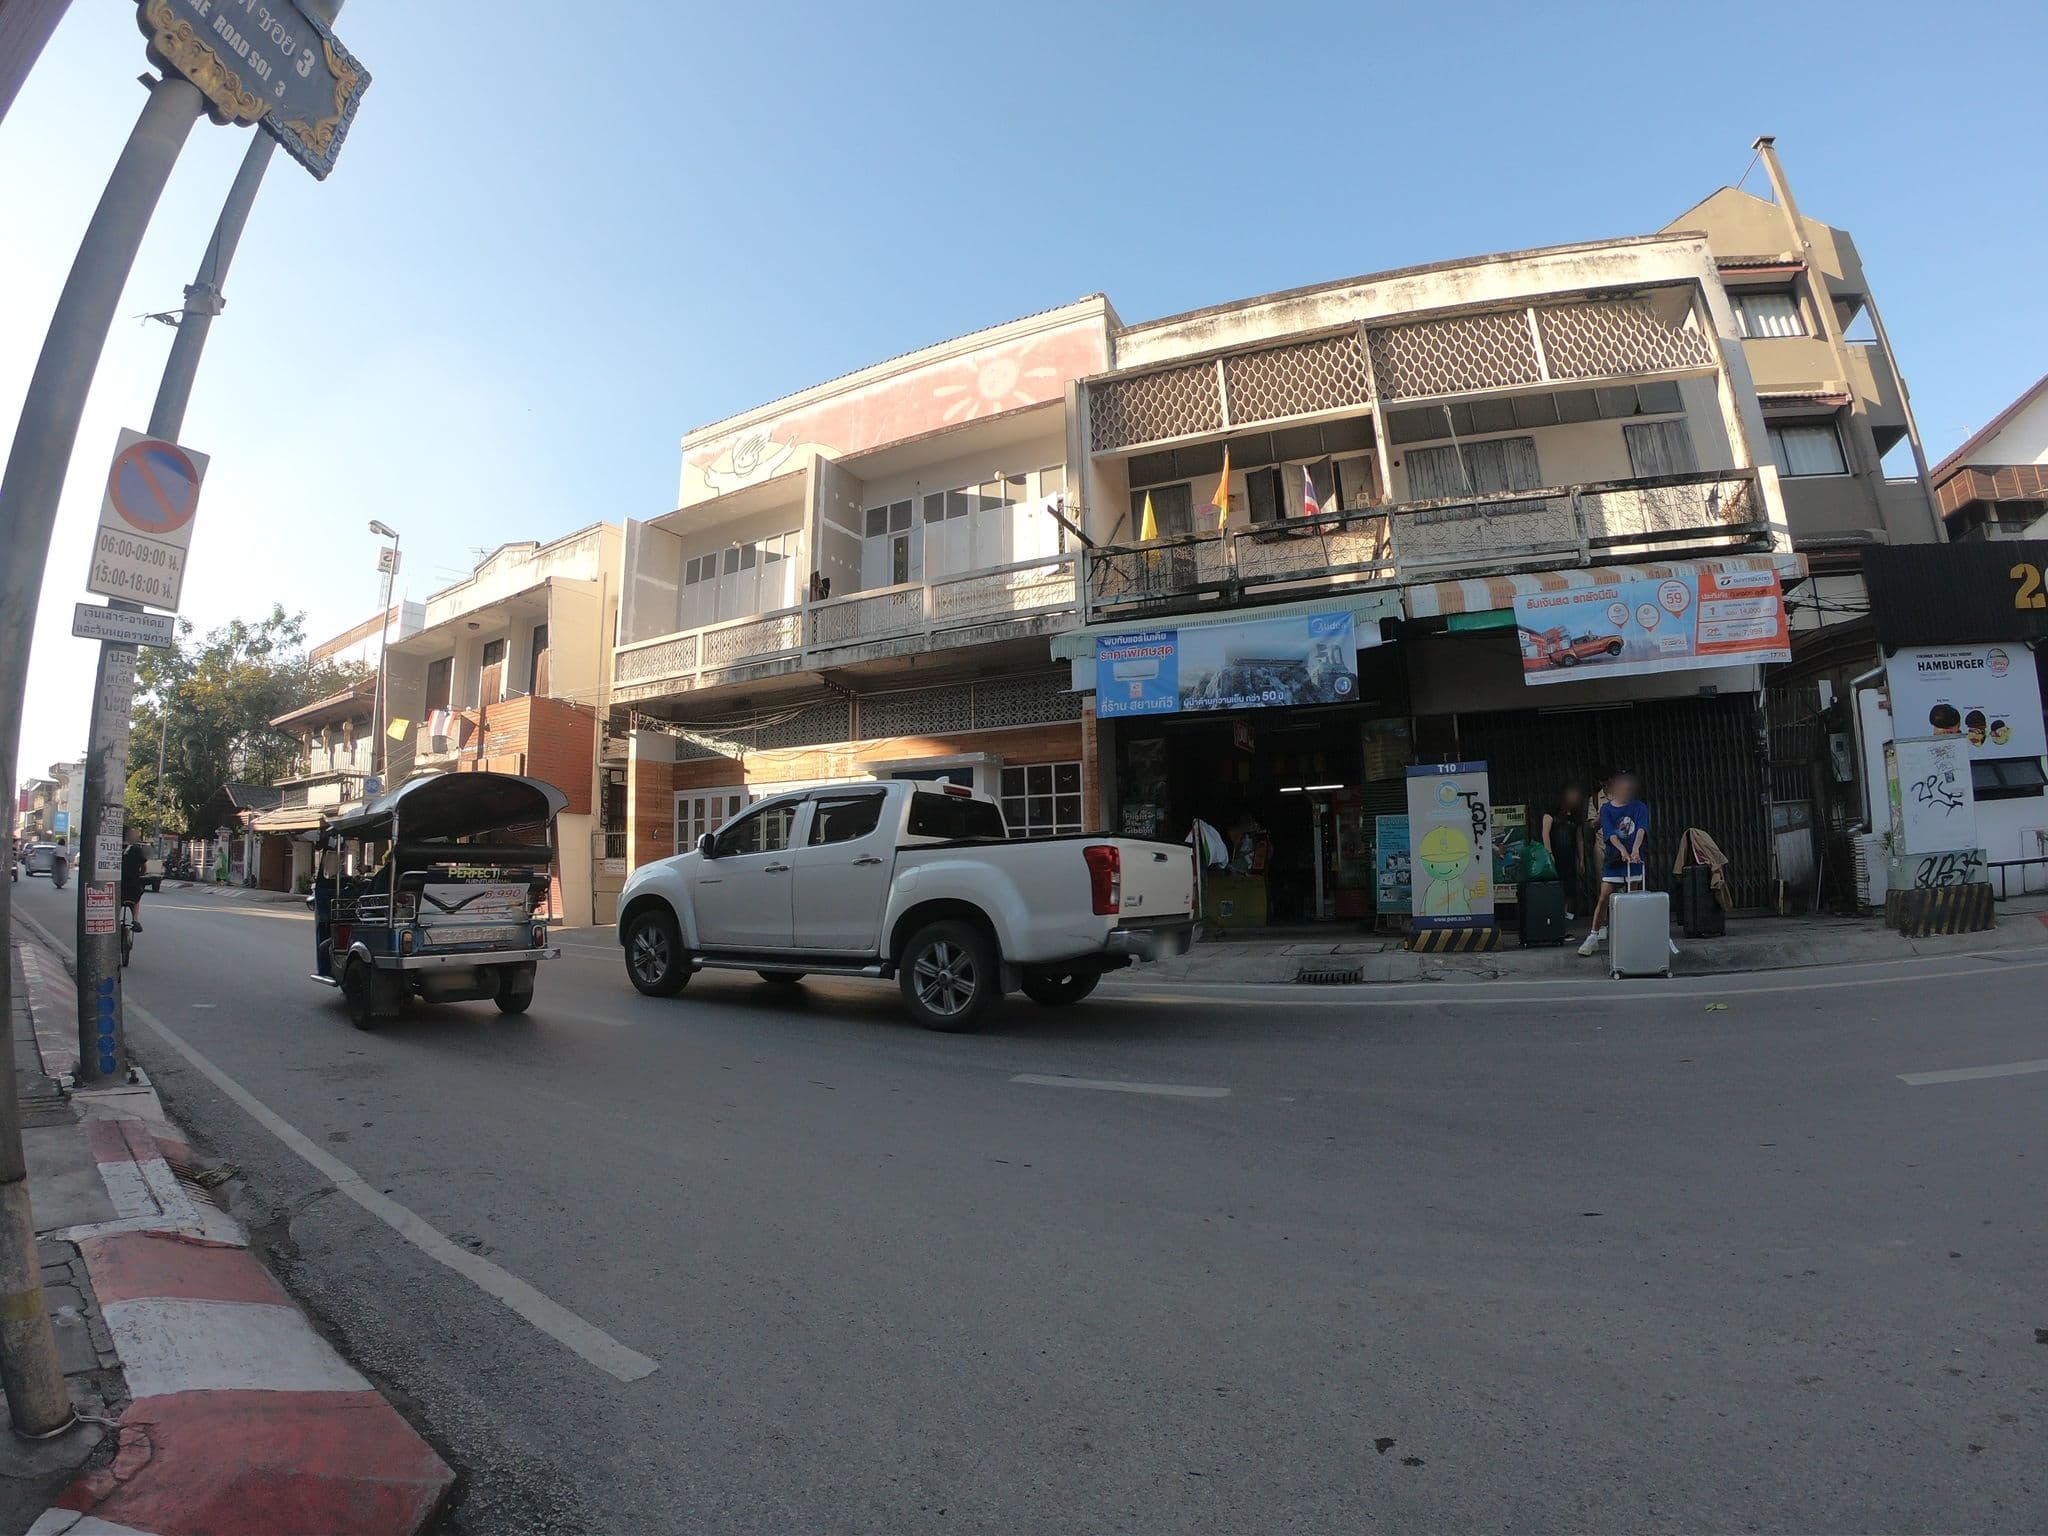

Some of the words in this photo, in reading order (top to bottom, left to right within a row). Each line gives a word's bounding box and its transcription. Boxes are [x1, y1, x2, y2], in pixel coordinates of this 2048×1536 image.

[187, 0, 212, 17] AE
[212, 14, 250, 58] ROAD
[247, 50, 273, 81] SOI
[274, 80, 287, 97] 3
[258, 8, 296, 56] ซอย
[296, 48, 316, 78] 3
[100, 534, 166, 568] 06:00-09:00
[94, 563, 159, 596] 15:00-18:00
[1666, 592, 1682, 604] 59
[1100, 646, 1173, 662] ราคาพิเศษสุด
[1917, 658, 1984, 673] HAMBURGER
[1262, 690, 1276, 701] 50
[1129, 696, 1174, 711] สยามทีวี
[1437, 764, 1456, 773] T10
[1124, 825, 1154, 834] Gibbon
[448, 867, 498, 879] PERFECT
